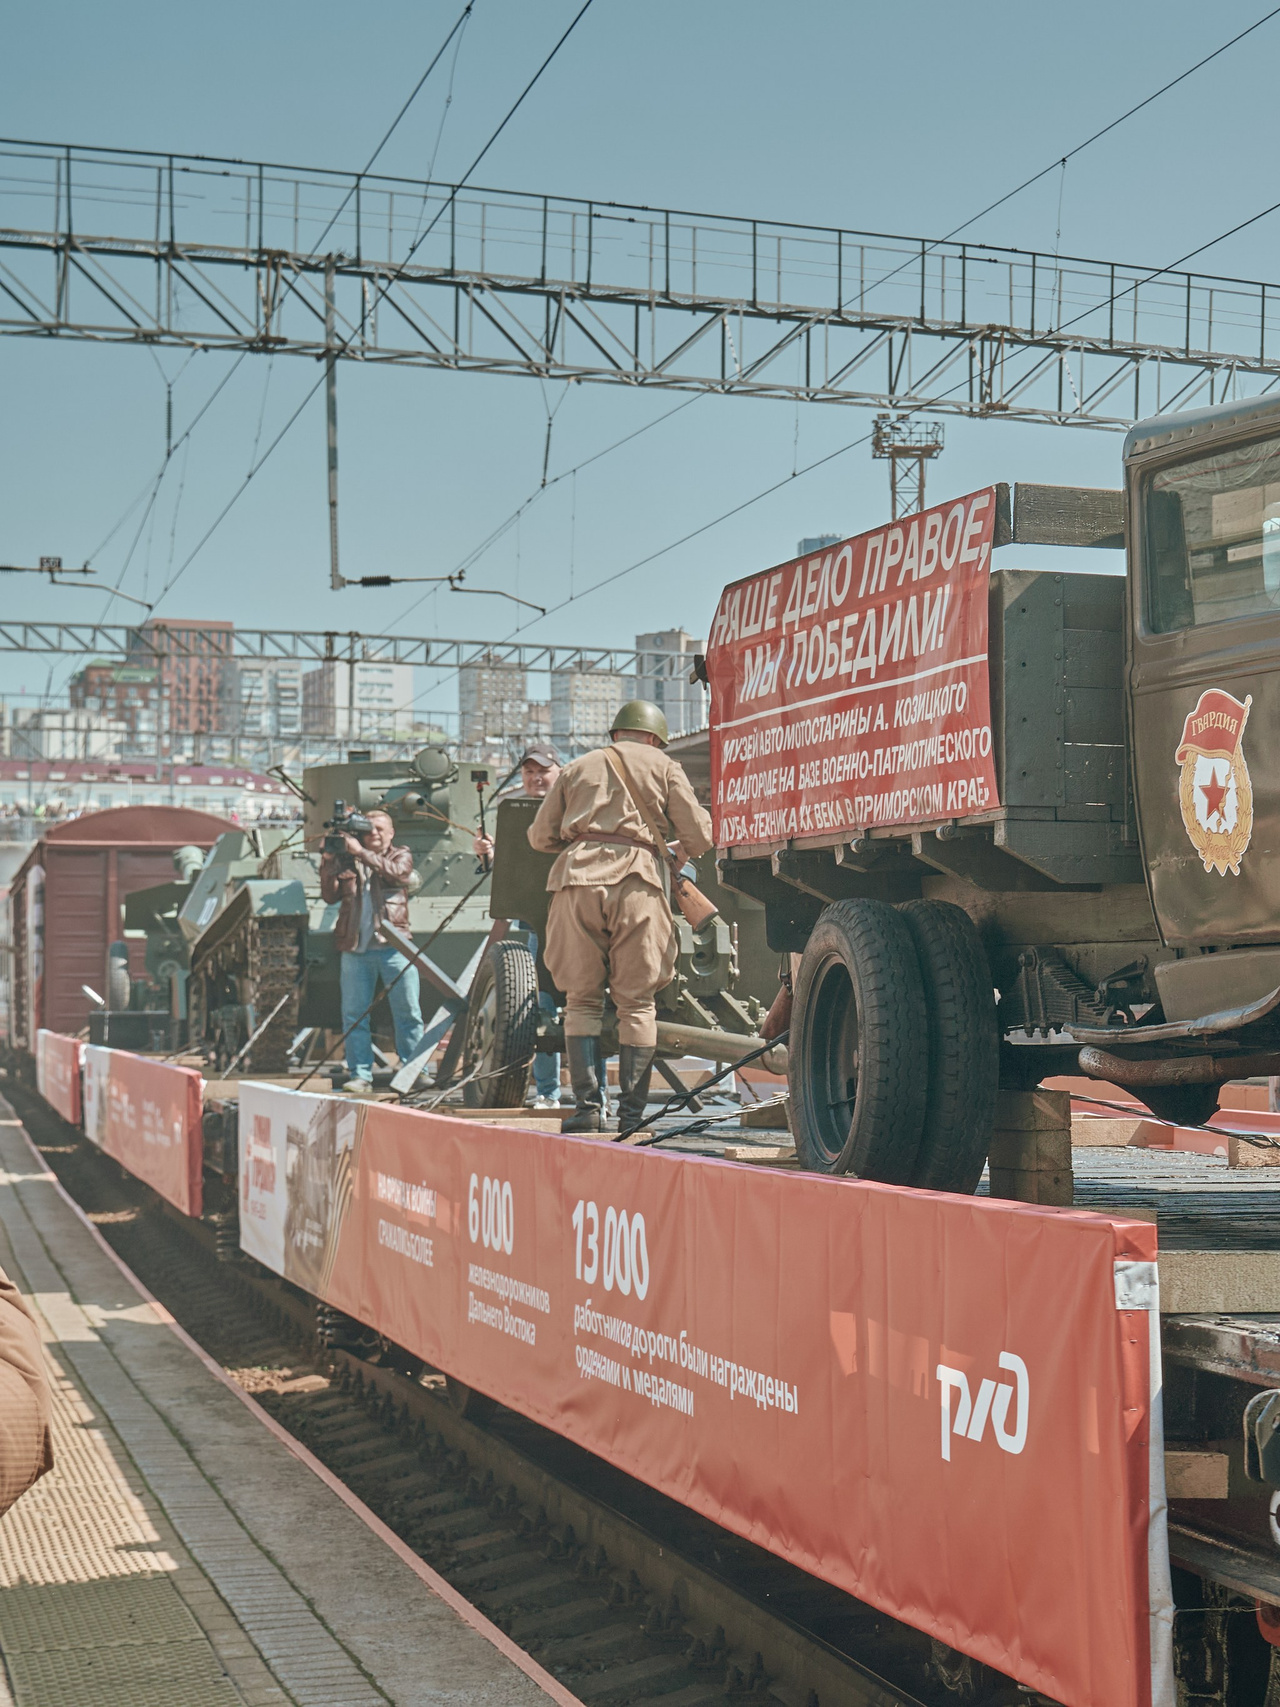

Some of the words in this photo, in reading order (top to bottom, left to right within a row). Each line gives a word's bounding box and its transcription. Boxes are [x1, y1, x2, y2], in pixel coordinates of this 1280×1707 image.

[710, 572, 783, 650] НАШЕ
[782, 545, 853, 636] ДЕЛО
[858, 494, 991, 599] ПРАВОЕ,
[739, 638, 786, 704] МЫ
[786, 584, 951, 690] ПОБЕДИЛИ!
[723, 727, 759, 765] МУЗЕЙ
[759, 704, 872, 757] АВТОМОТОСТАРИНЫ
[873, 703, 889, 732] А.
[893, 681, 967, 729] КОЗИЦКОГО
[1191, 711, 1239, 738] ГВАРДИЯ
[778, 765, 795, 793] НА
[798, 760, 821, 790] БАЗЕ
[822, 726, 992, 785] ВОЕННО-ПАТРИОТИЧЕСКОГО
[814, 800, 846, 829] ВЕКА
[845, 798, 856, 824] В
[854, 781, 942, 824] ПРИМОРСКОМ
[468, 1263, 551, 1314] железнодорожников
[468, 1290, 503, 1331] Дальнего
[504, 1305, 536, 1346] Востока
[573, 1298, 632, 1348] работников
[631, 1326, 678, 1365] дороги
[679, 1330, 709, 1379] были
[710, 1354, 799, 1415] награждены
[575, 1344, 621, 1388] орденами
[621, 1365, 632, 1391] и
[632, 1368, 694, 1418] медалями
